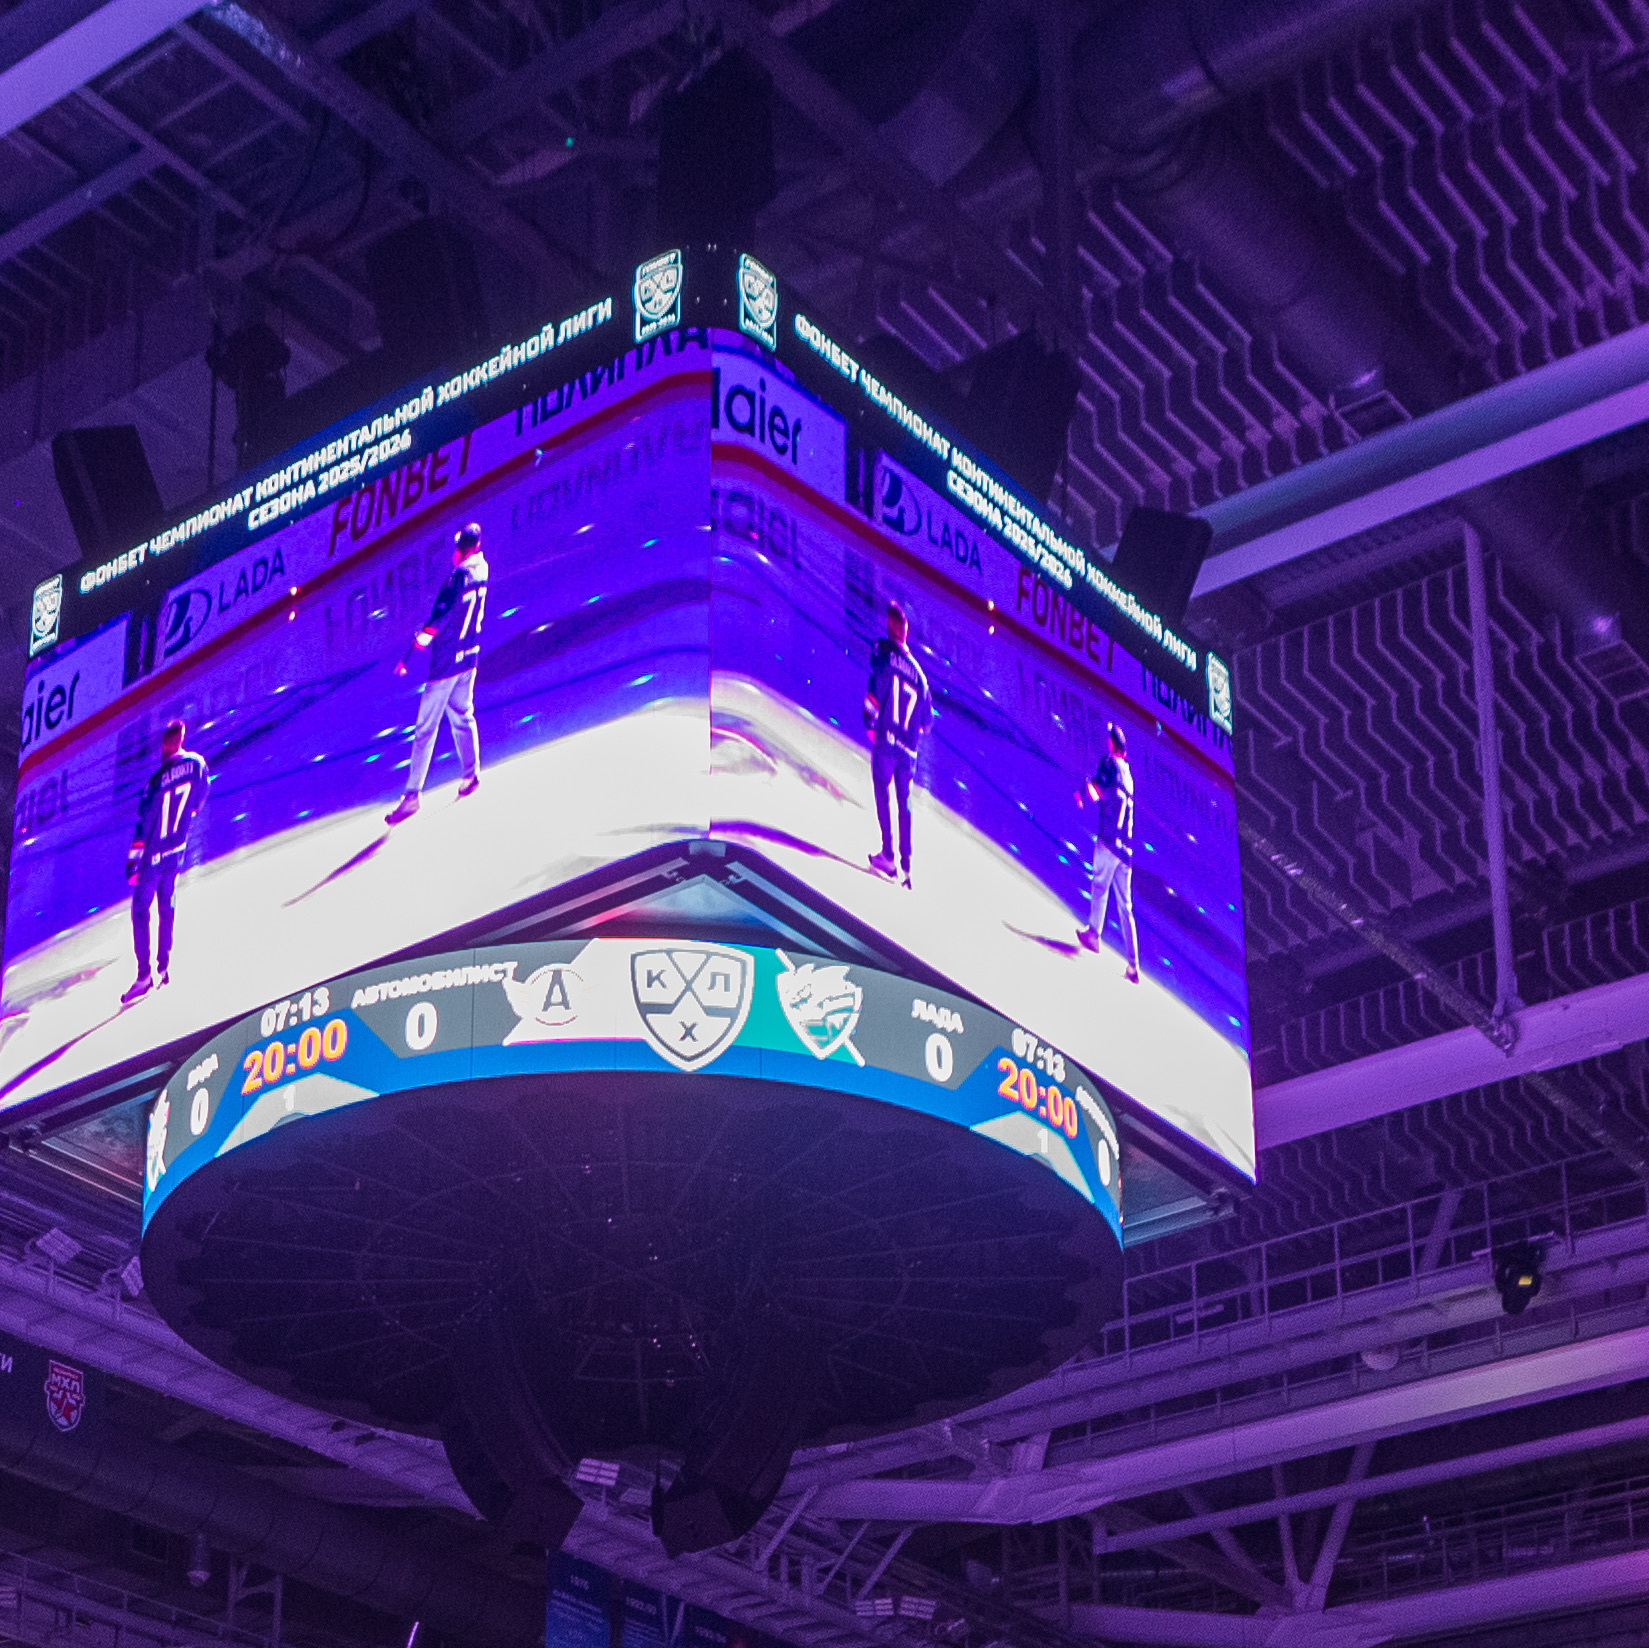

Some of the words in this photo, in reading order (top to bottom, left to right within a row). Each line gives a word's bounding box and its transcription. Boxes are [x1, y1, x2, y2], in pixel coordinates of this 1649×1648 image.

[78, 542, 149, 594] ФОНБЕТ
[149, 486, 253, 556] ЧЕМПИОНАТ
[255, 385, 435, 502] КОНТИНЕНТАЛЬНОЙ
[437, 322, 555, 406] ХОККЕЙНОЙ
[556, 297, 612, 345] ЛИГИ
[713, 366, 801, 465] aier
[247, 478, 317, 531] СЕЗОНА
[317, 428, 412, 494] 2025/2026
[793, 314, 860, 383] ФОНБЕТ
[859, 369, 951, 461] ЧЕМПИОНАТ
[951, 446, 1086, 577] КОНТИНЕНТАЛЬНОЙ
[1162, 628, 1198, 673] ЛИГИ
[927, 503, 983, 577] LADA
[946, 469, 1004, 531] СЕЗОНА
[1003, 516, 1073, 590] 2025/2026
[217, 547, 285, 613] LADA
[893, 673, 918, 731] 17
[160, 781, 192, 839] 17
[260, 986, 331, 1038] 07:13
[351, 961, 518, 1009] АВТОМОБИЛИСТ
[241, 1018, 349, 1096] 20:00
[404, 1001, 439, 1051] 0
[923, 1032, 954, 1082] 0
[189, 1086, 211, 1136] 0
[996, 1056, 1080, 1139] 20:00
[51, 1373, 81, 1392] МХЛ
